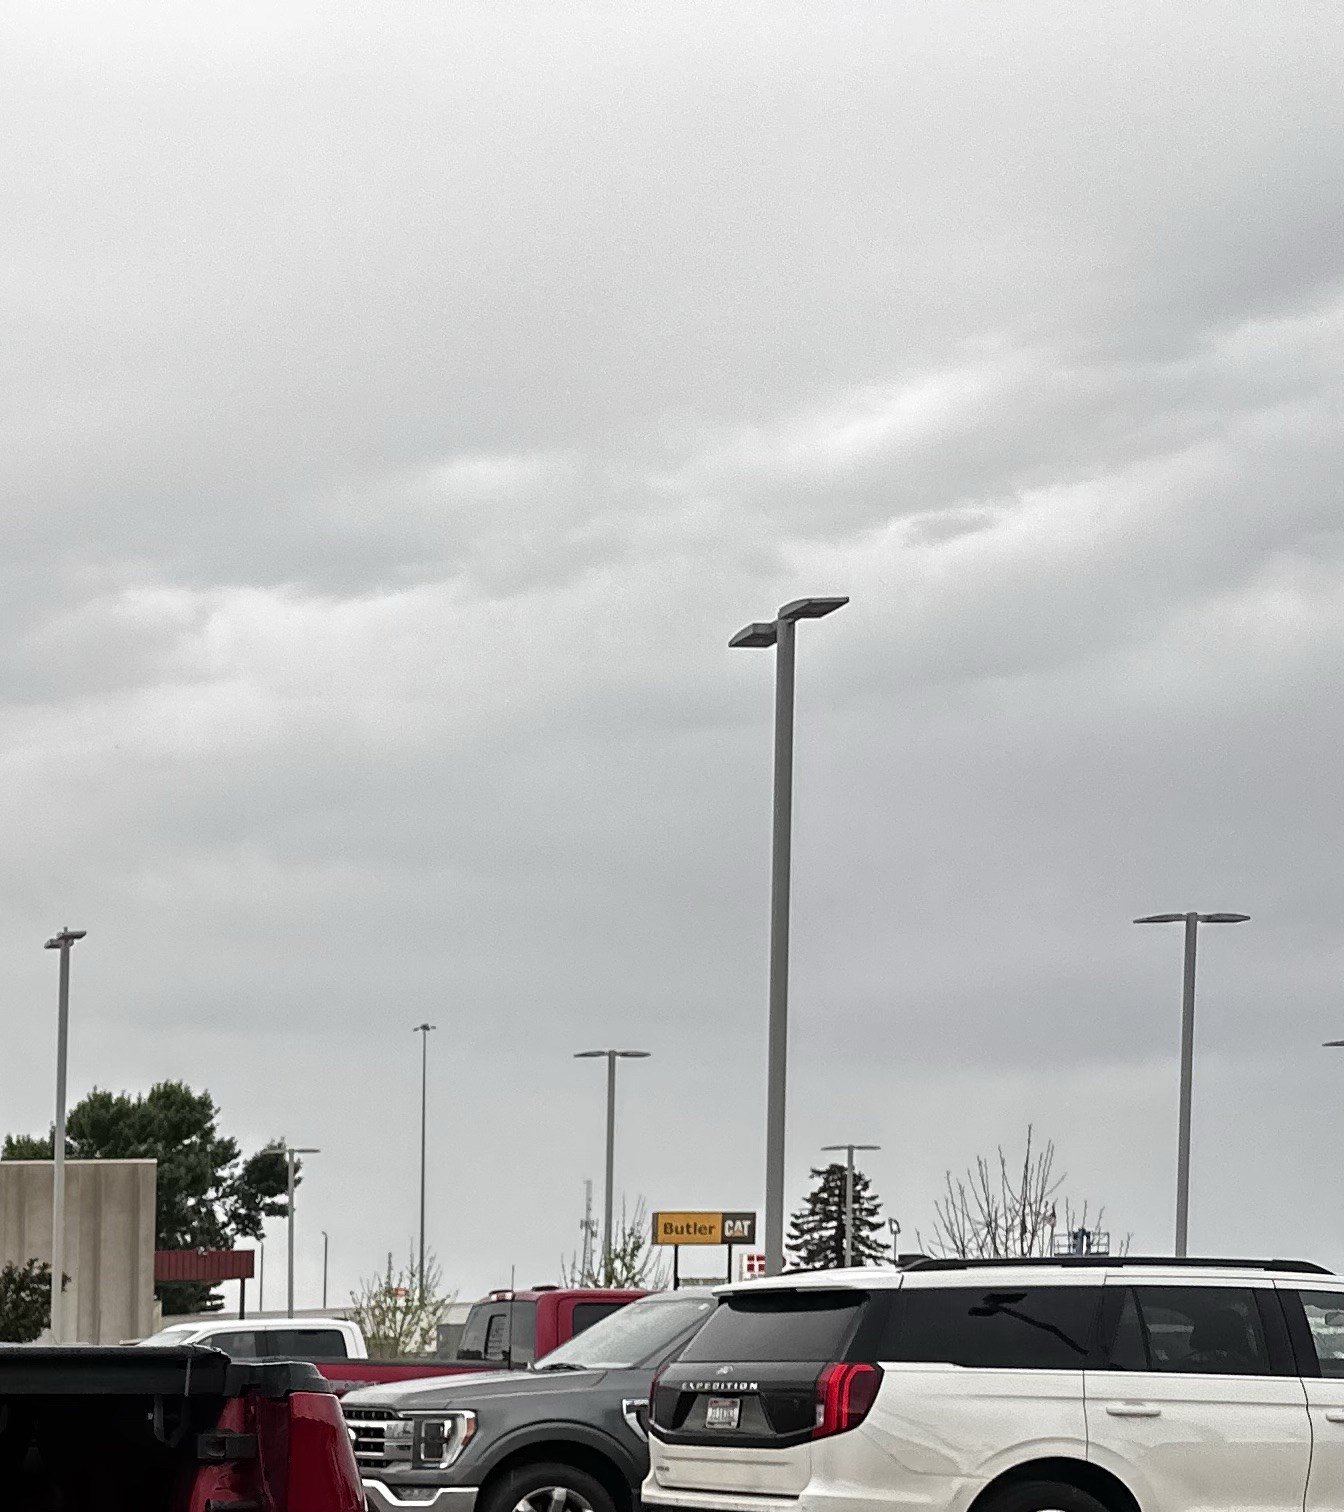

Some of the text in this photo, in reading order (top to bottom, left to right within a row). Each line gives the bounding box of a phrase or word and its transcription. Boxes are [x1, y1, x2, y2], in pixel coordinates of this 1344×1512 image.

[663, 1219, 752, 1238] Butler CAT
[681, 1382, 758, 1390] EXPEDITION
